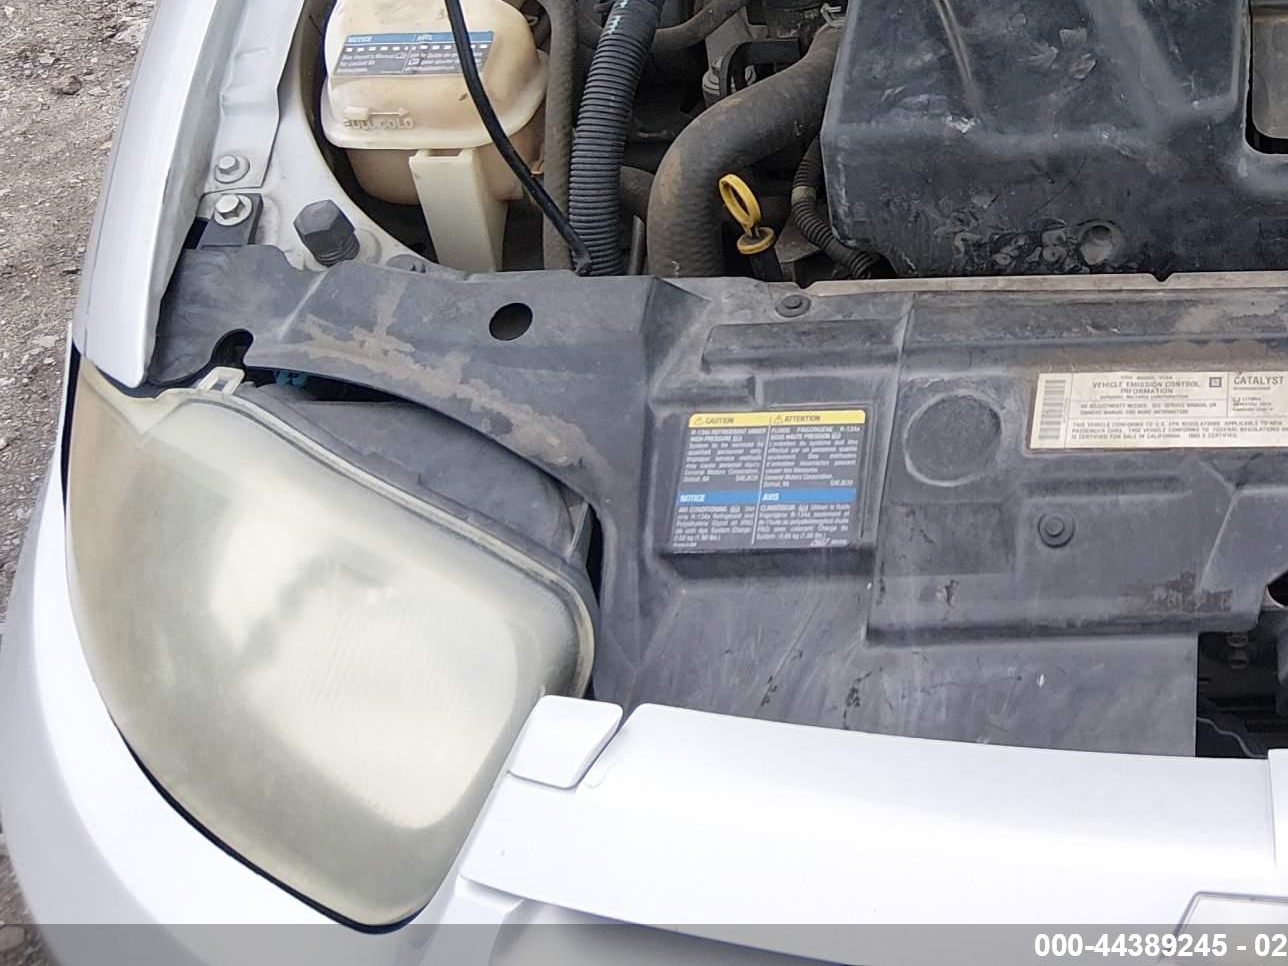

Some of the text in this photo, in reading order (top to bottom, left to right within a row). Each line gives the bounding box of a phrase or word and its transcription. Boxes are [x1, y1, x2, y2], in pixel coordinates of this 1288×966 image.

[347, 35, 373, 43] NOTICE
[1126, 380, 1163, 388] EMISSION
[1233, 375, 1285, 385] CATALYST
[704, 417, 735, 425] CAUTION
[680, 494, 705, 503] NOTICE
[762, 493, 779, 501] AVIS
